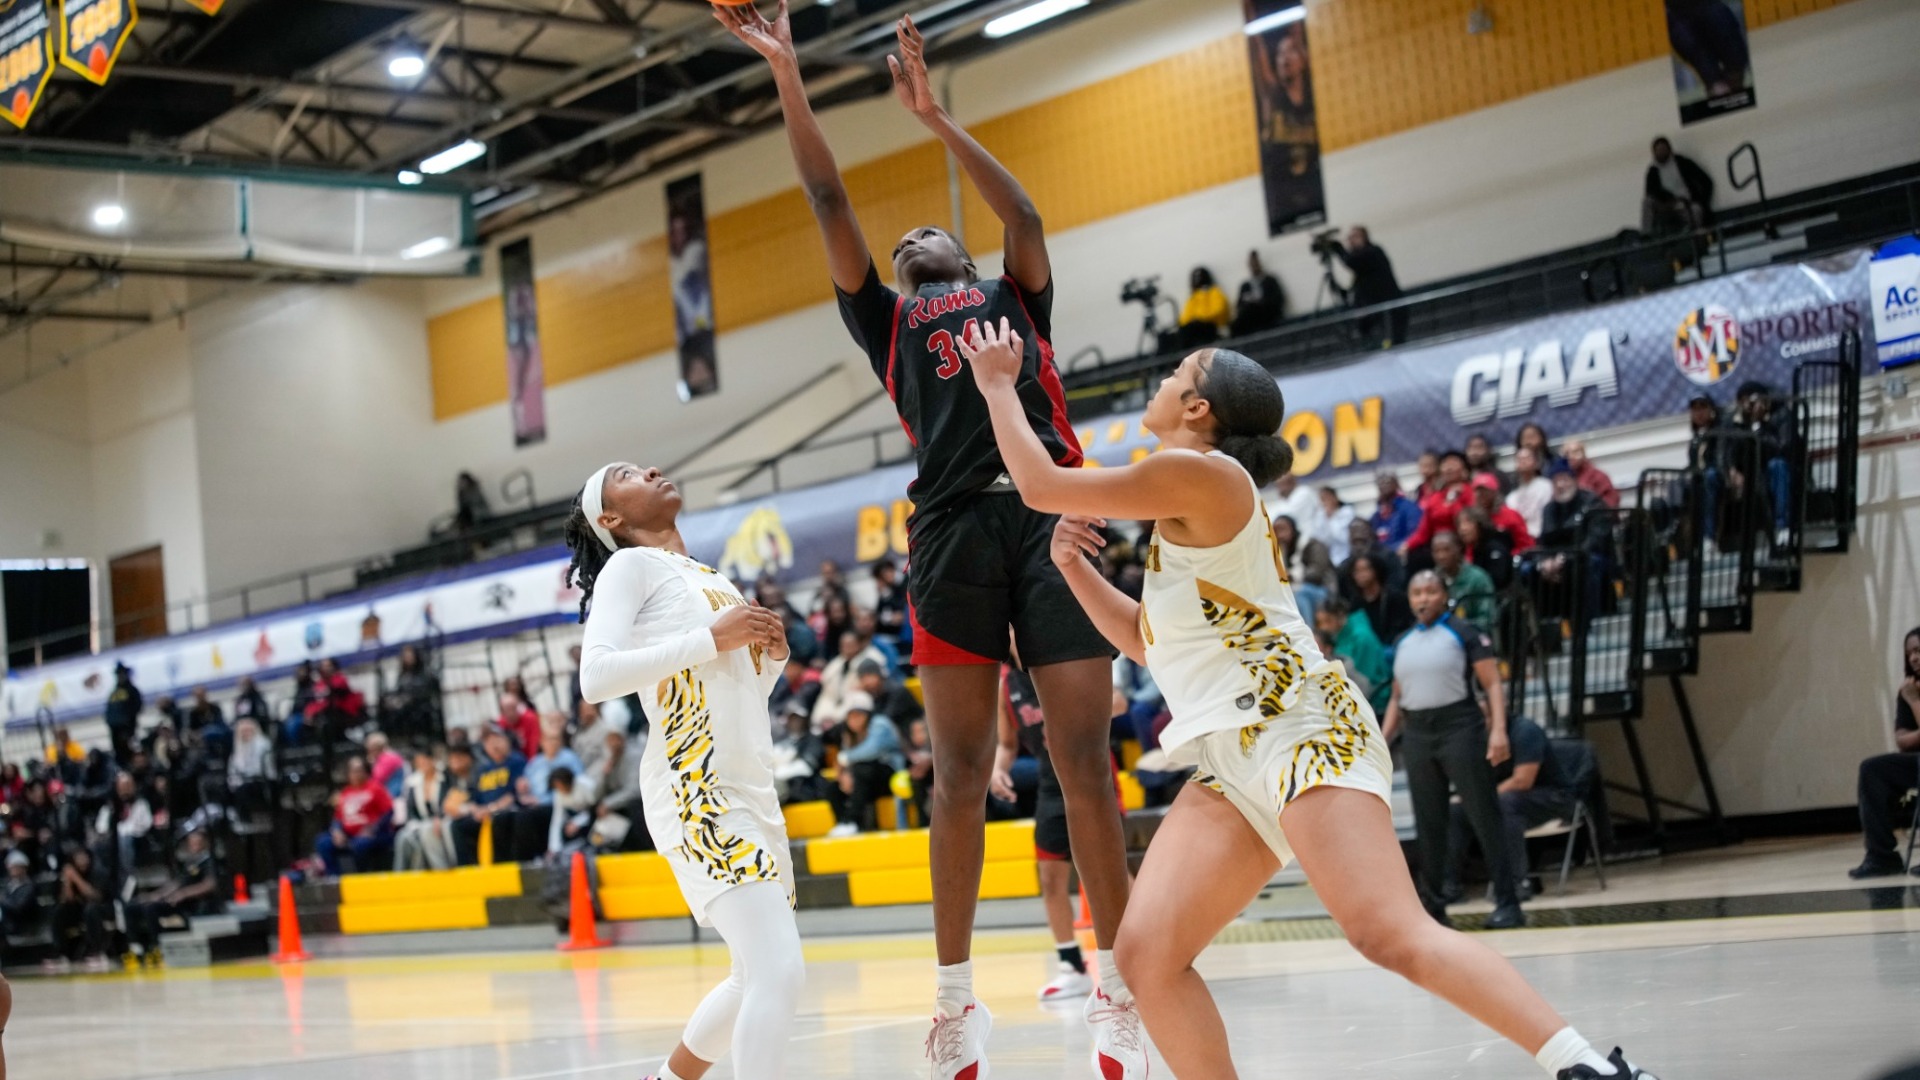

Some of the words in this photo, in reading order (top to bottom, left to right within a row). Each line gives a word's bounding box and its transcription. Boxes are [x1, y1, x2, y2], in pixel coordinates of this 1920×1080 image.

[908, 287, 985, 328] Rams
[1740, 299, 1860, 346] SPORTS
[1451, 328, 1619, 426] CIAA
